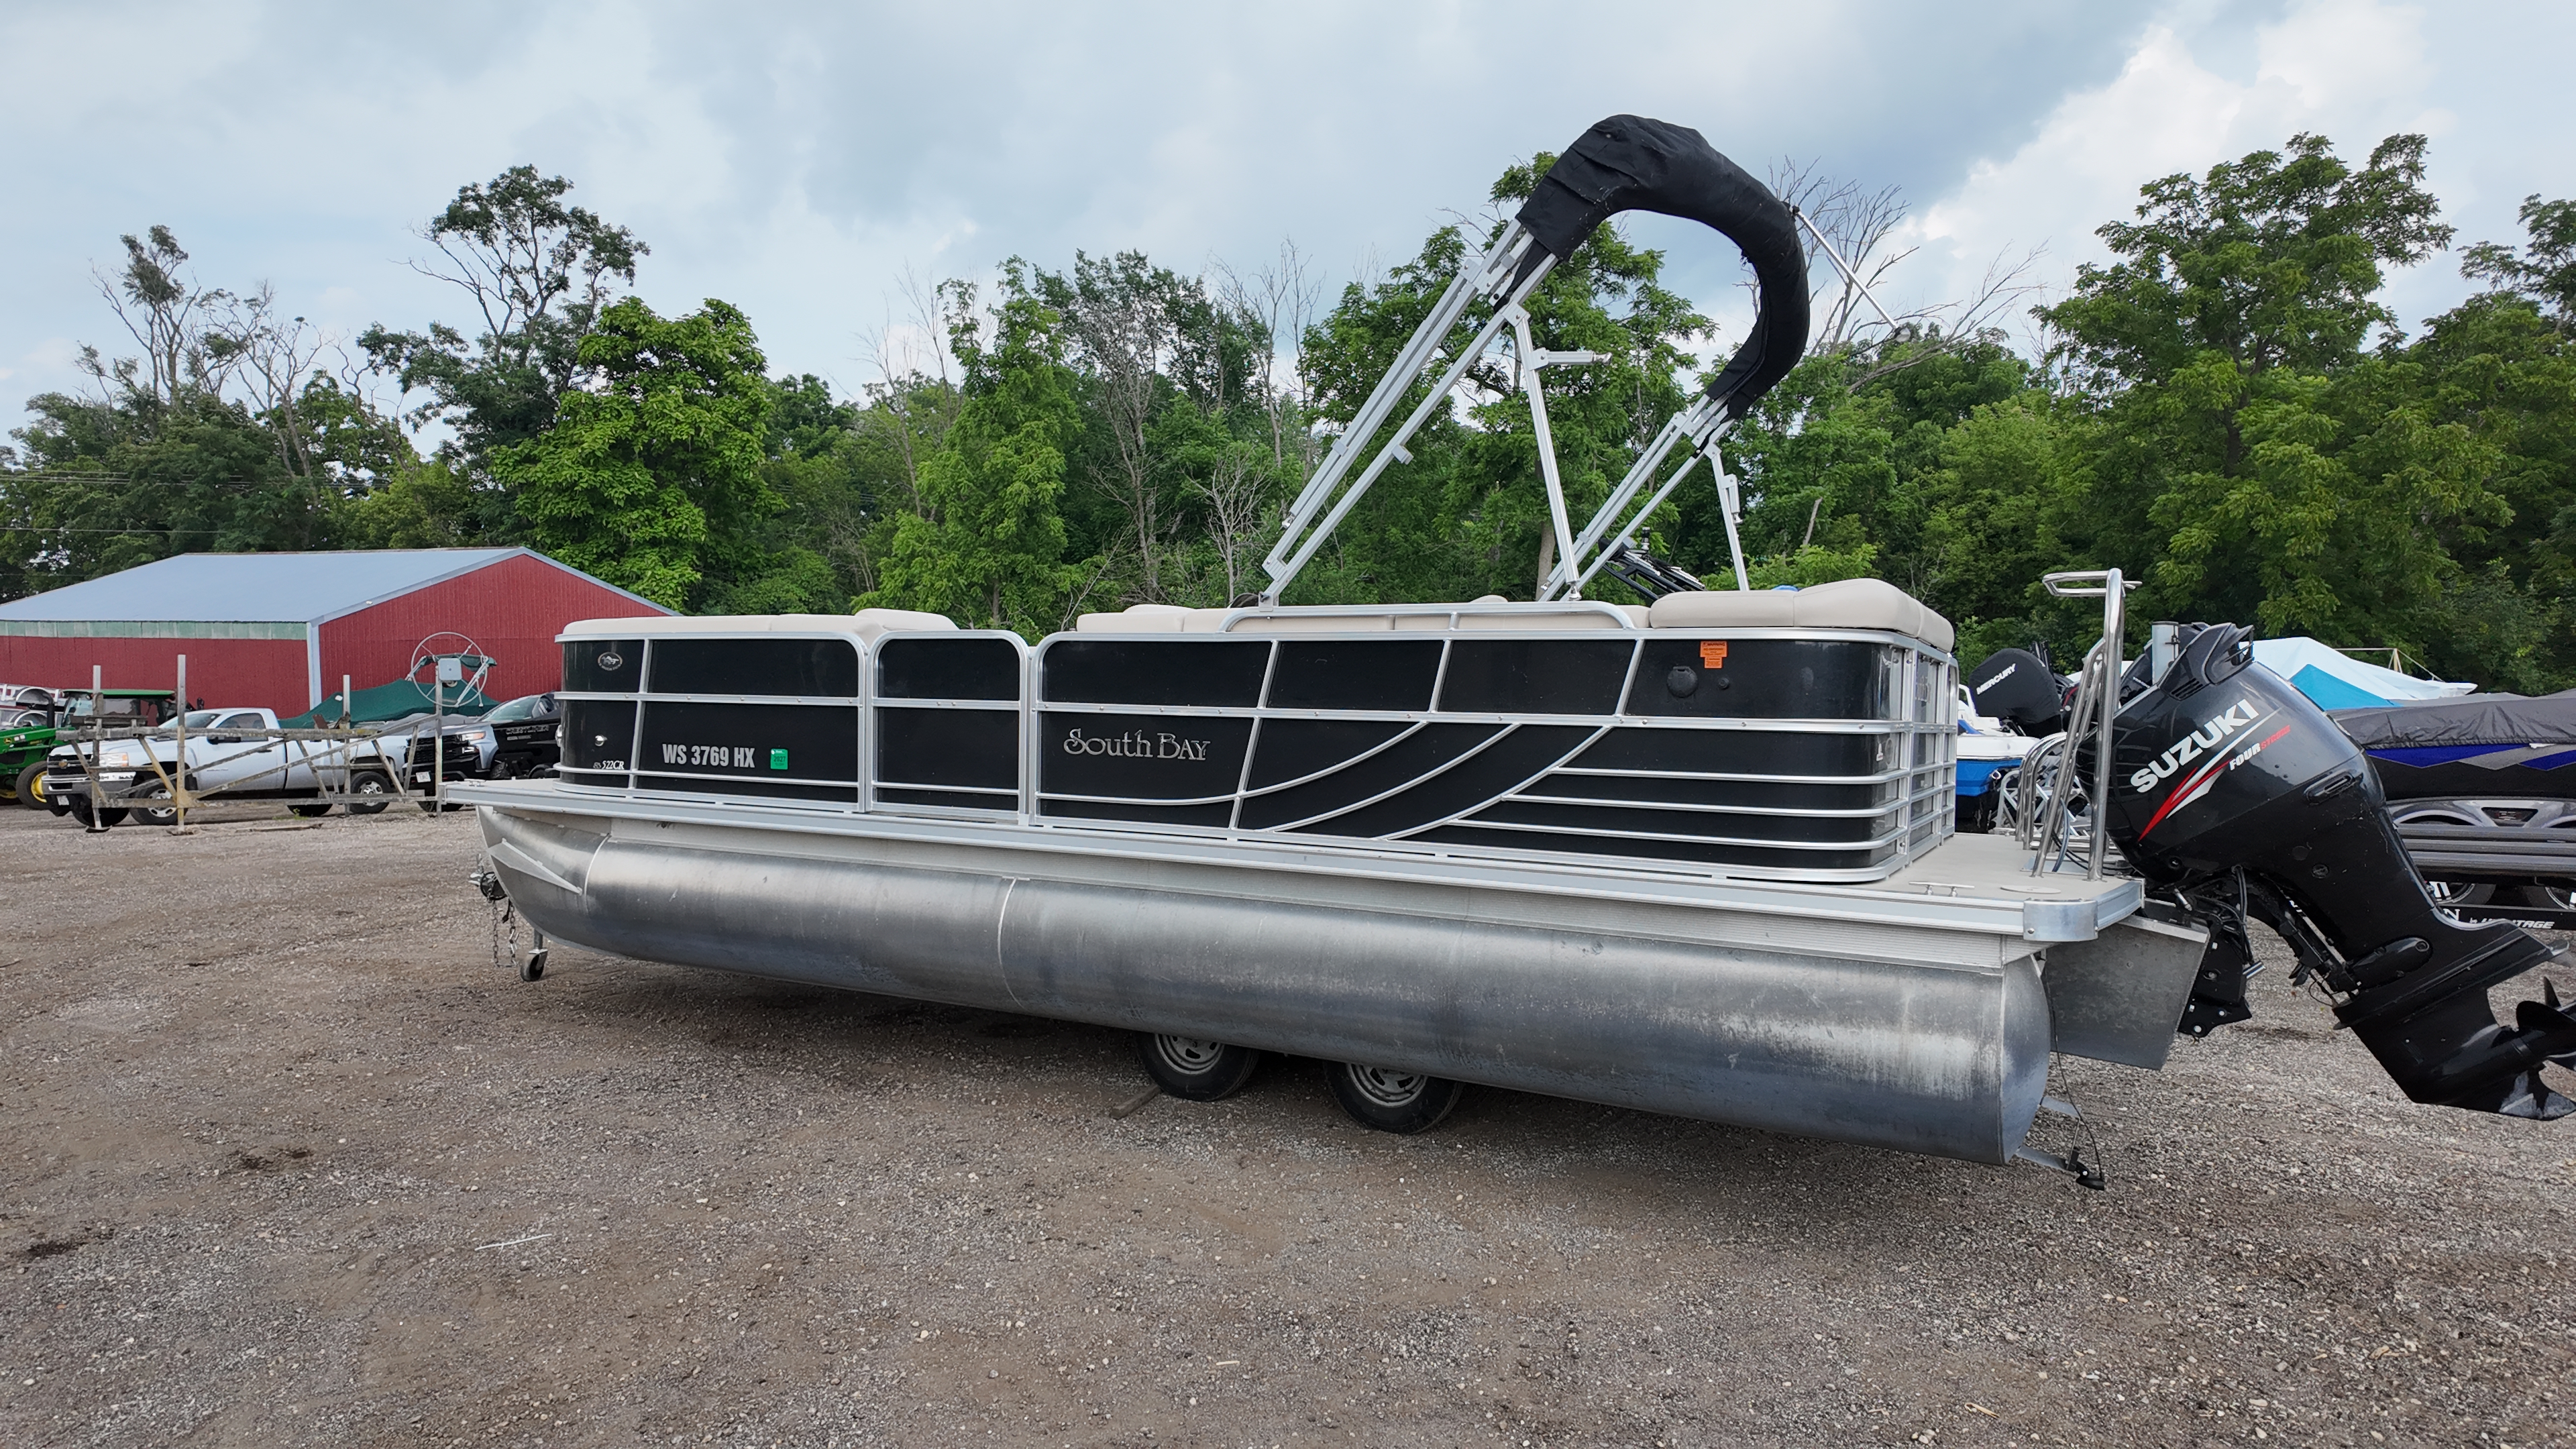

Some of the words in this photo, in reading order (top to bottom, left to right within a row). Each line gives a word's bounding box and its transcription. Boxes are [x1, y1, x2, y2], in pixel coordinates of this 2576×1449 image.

[1976, 663, 2017, 695] MERCURY
[662, 743, 687, 765] WS
[691, 745, 729, 766] 3769
[734, 747, 755, 768] HX
[1063, 728, 1153, 757] South
[1157, 733, 1211, 761] BAY
[2130, 699, 2259, 793] SUZUKI
